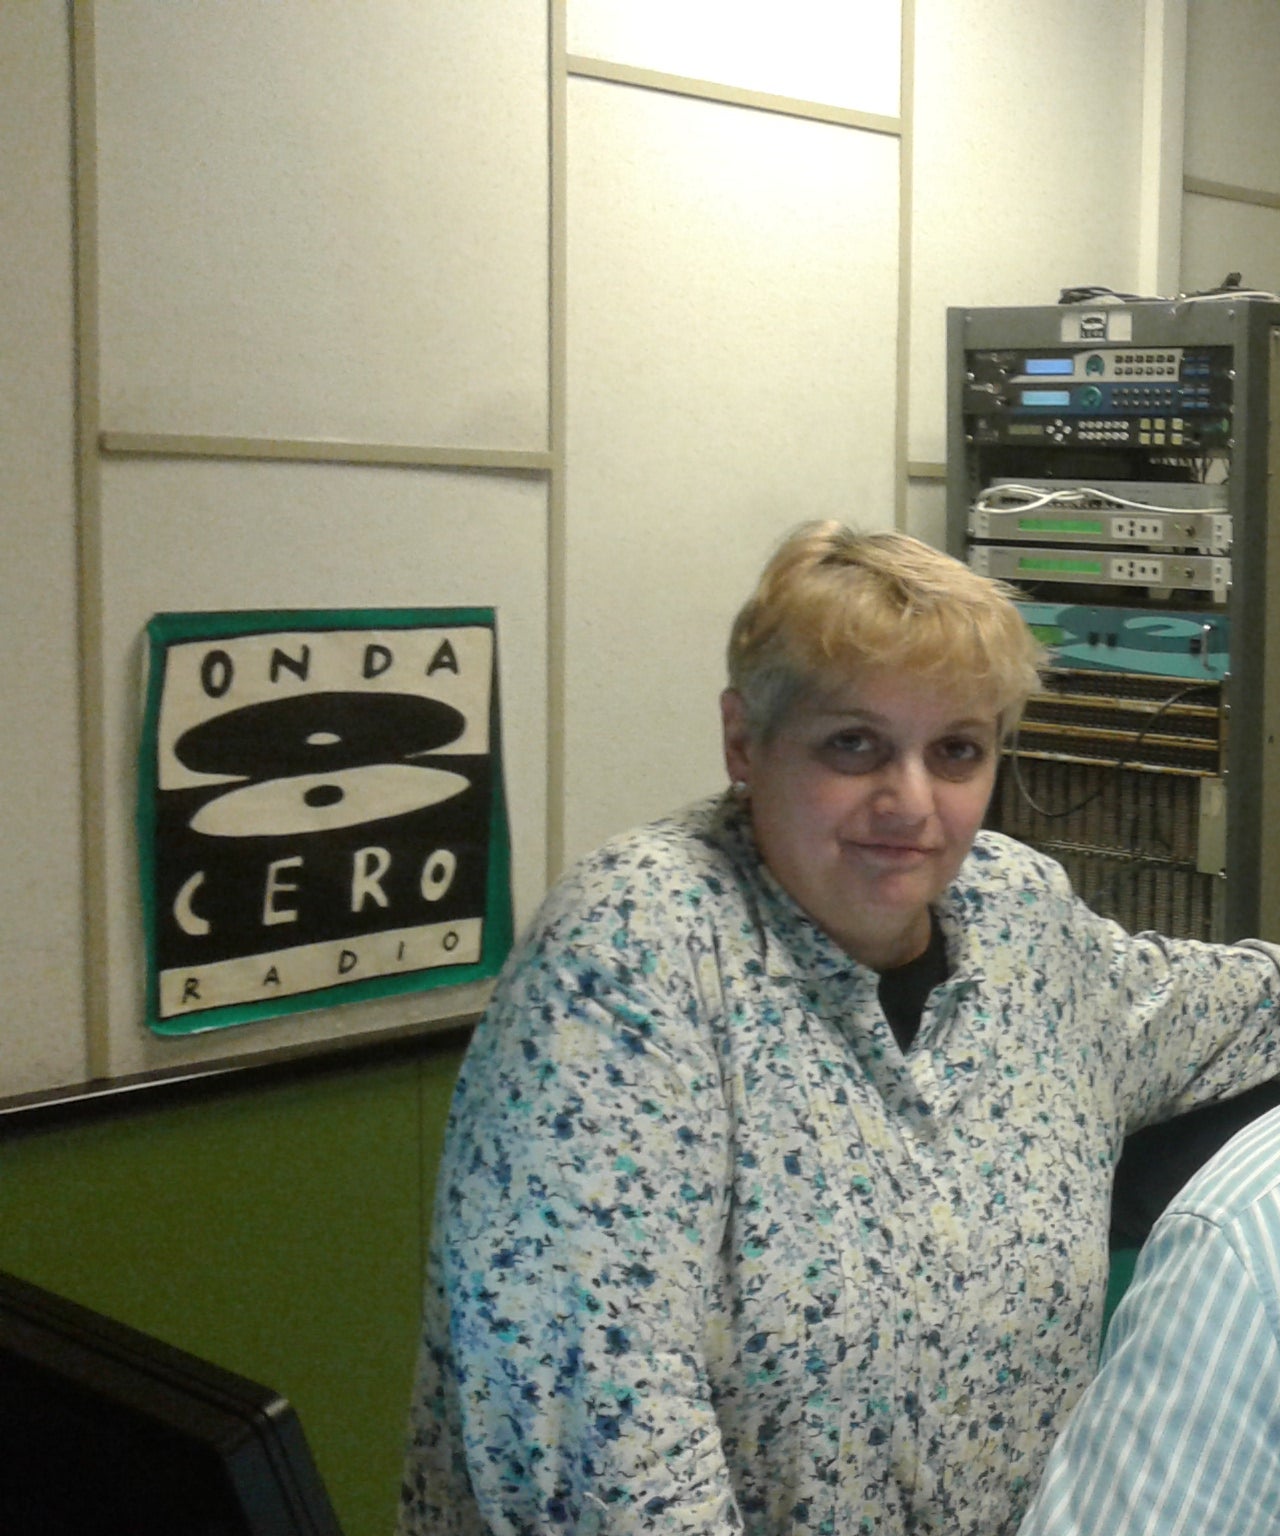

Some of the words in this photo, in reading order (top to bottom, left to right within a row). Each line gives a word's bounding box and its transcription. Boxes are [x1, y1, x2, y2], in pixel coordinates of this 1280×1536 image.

[201, 638, 459, 698] ONDA
[172, 846, 457, 935] CERO
[181, 931, 460, 1004] RADIO
